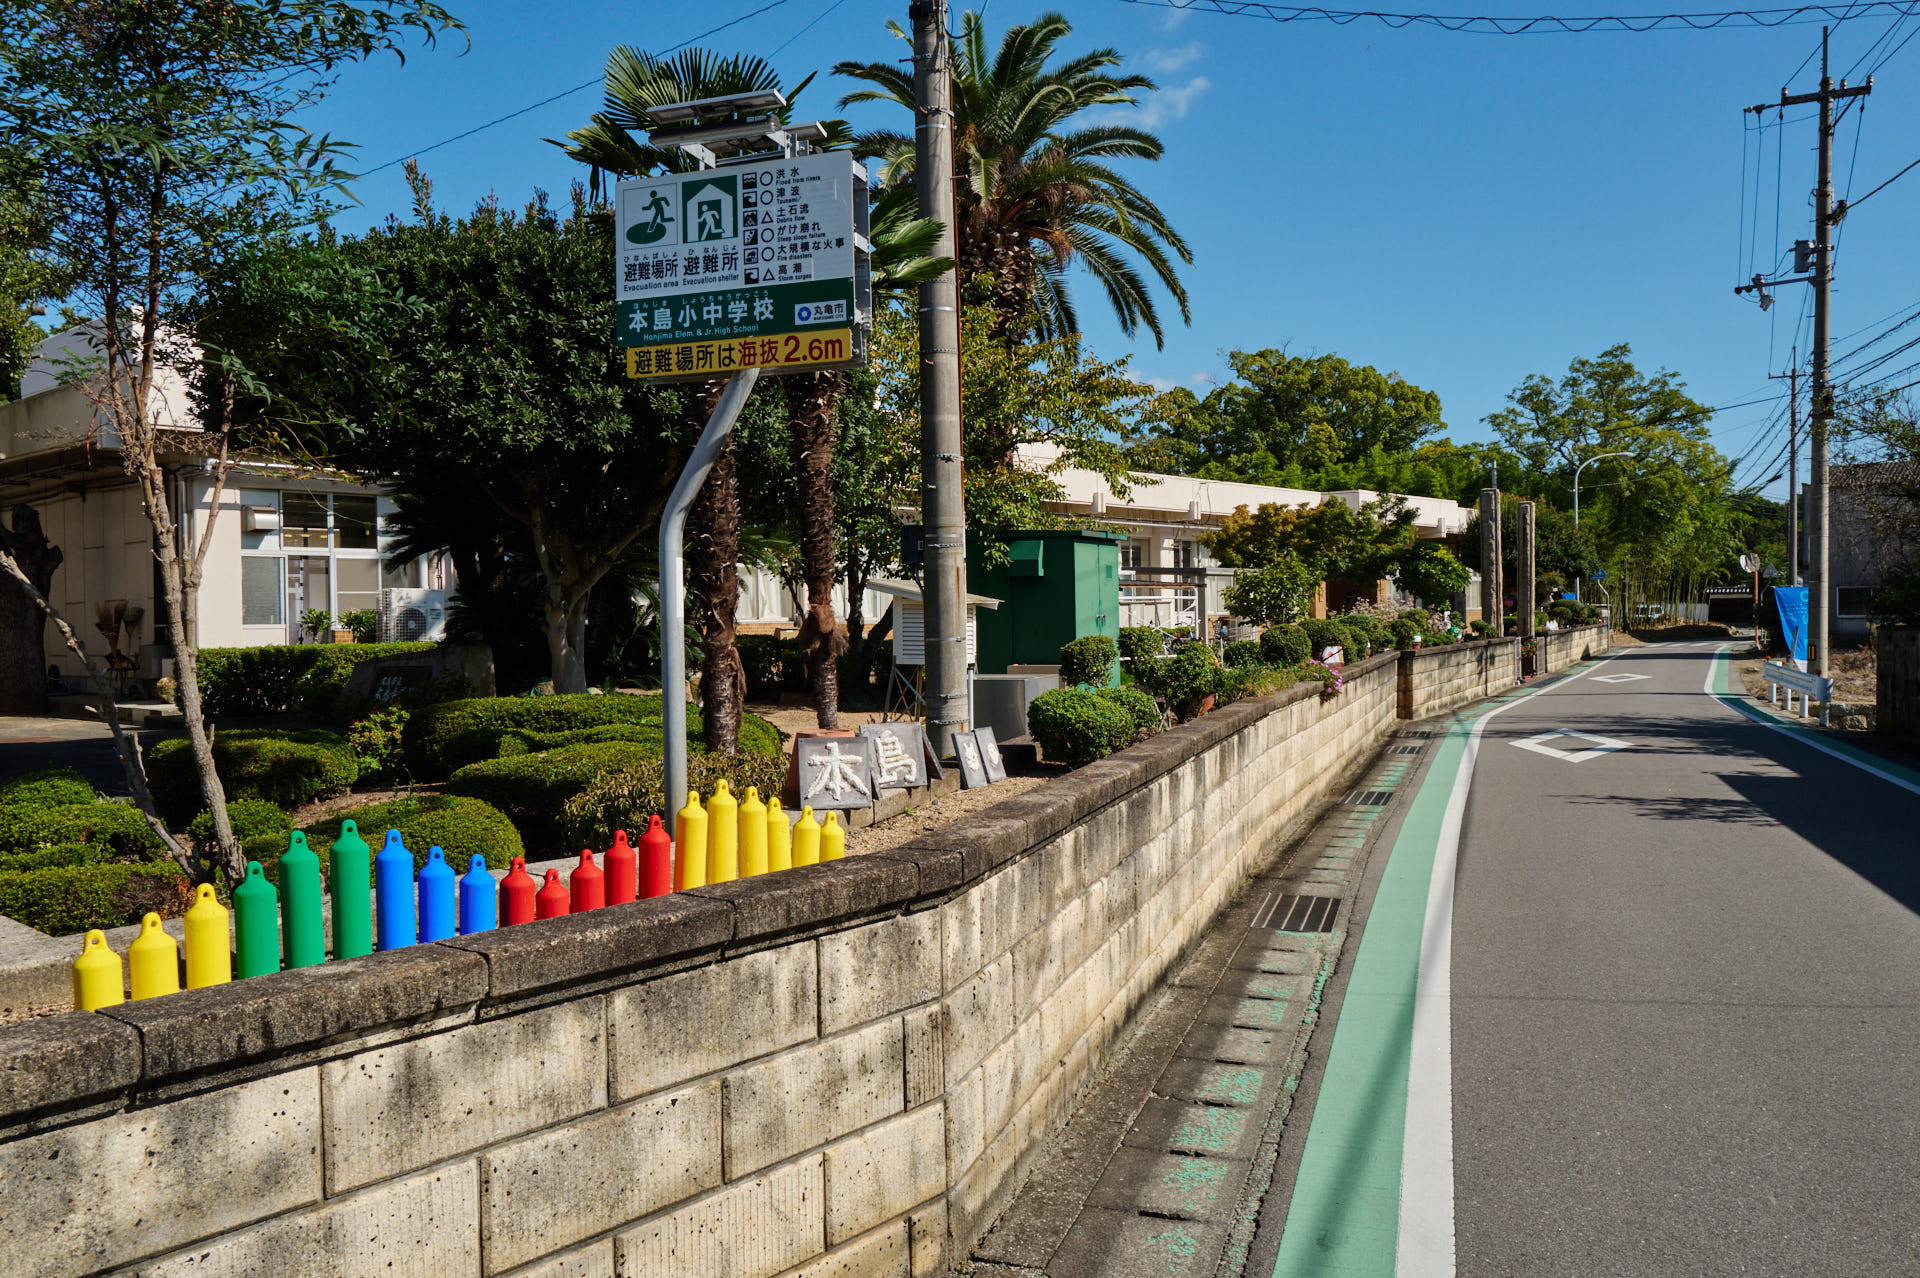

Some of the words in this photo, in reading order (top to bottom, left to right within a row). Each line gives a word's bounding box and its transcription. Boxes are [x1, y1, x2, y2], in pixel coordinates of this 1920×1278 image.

[776, 166, 800, 179] 洪水
[776, 186, 800, 198] 津波
[777, 203, 809, 217] 土石流
[777, 222, 821, 236] がけ崩れ
[777, 237, 845, 255] 大規模な火事
[624, 251, 678, 263] ひなんばしょ
[789, 253, 813, 261] disasters
[624, 258, 679, 282] 避難場所
[683, 252, 739, 276] 避難所
[778, 262, 802, 275] 高潮
[624, 281, 662, 292] Evacuation
[663, 280, 679, 288] area
[682, 276, 717, 286] Evacuation
[718, 273, 740, 282] shelter
[628, 296, 775, 333] 本島小中学校
[814, 303, 844, 315] 丸亀市
[643, 333, 673, 342] Honjima
[675, 330, 695, 339] Elem.
[696, 329, 703, 337] &
[733, 324, 759, 333] School
